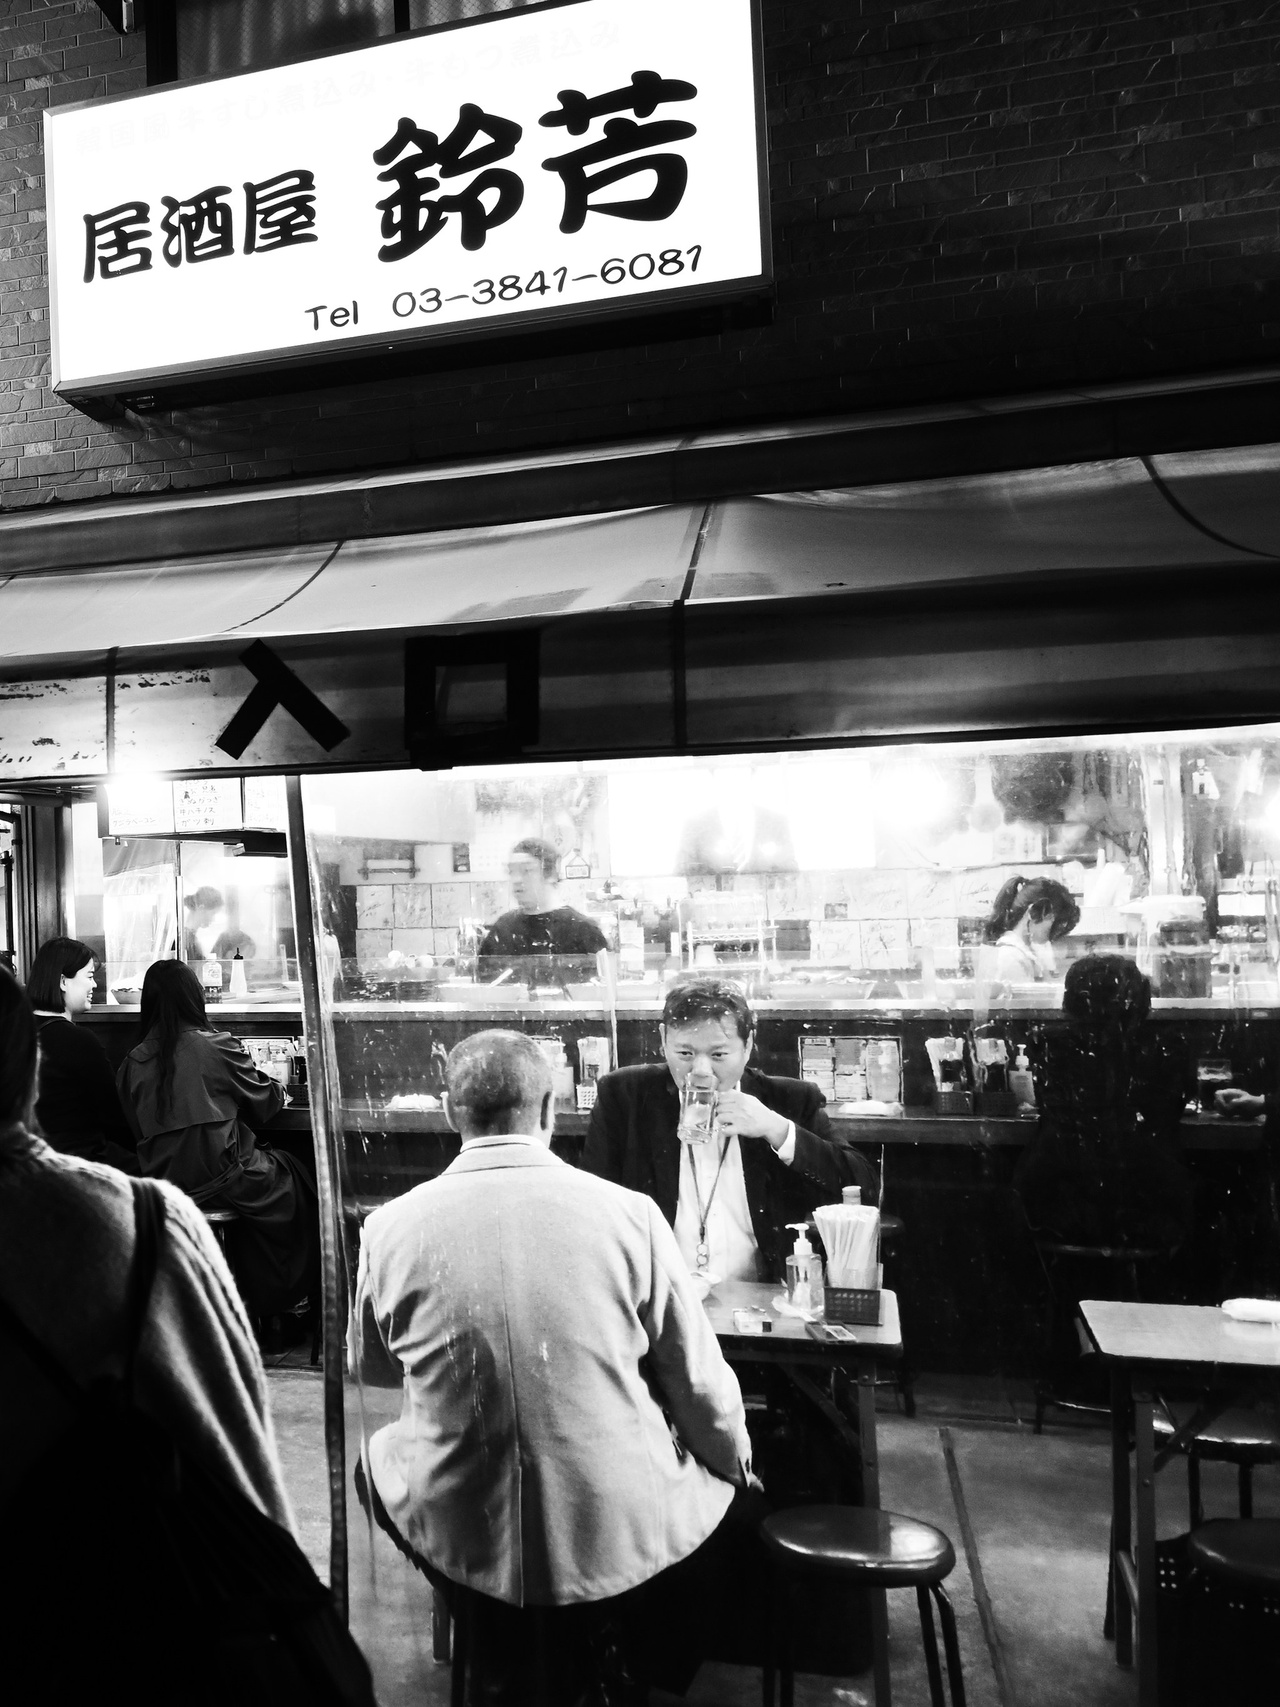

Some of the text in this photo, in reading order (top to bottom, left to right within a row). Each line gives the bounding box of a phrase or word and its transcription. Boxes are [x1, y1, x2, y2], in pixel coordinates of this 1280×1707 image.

[82, 70, 698, 284] 居酒屋 鈴芳
[305, 244, 702, 331] Tel 03-3841-6081
[215, 629, 540, 766] 入口
